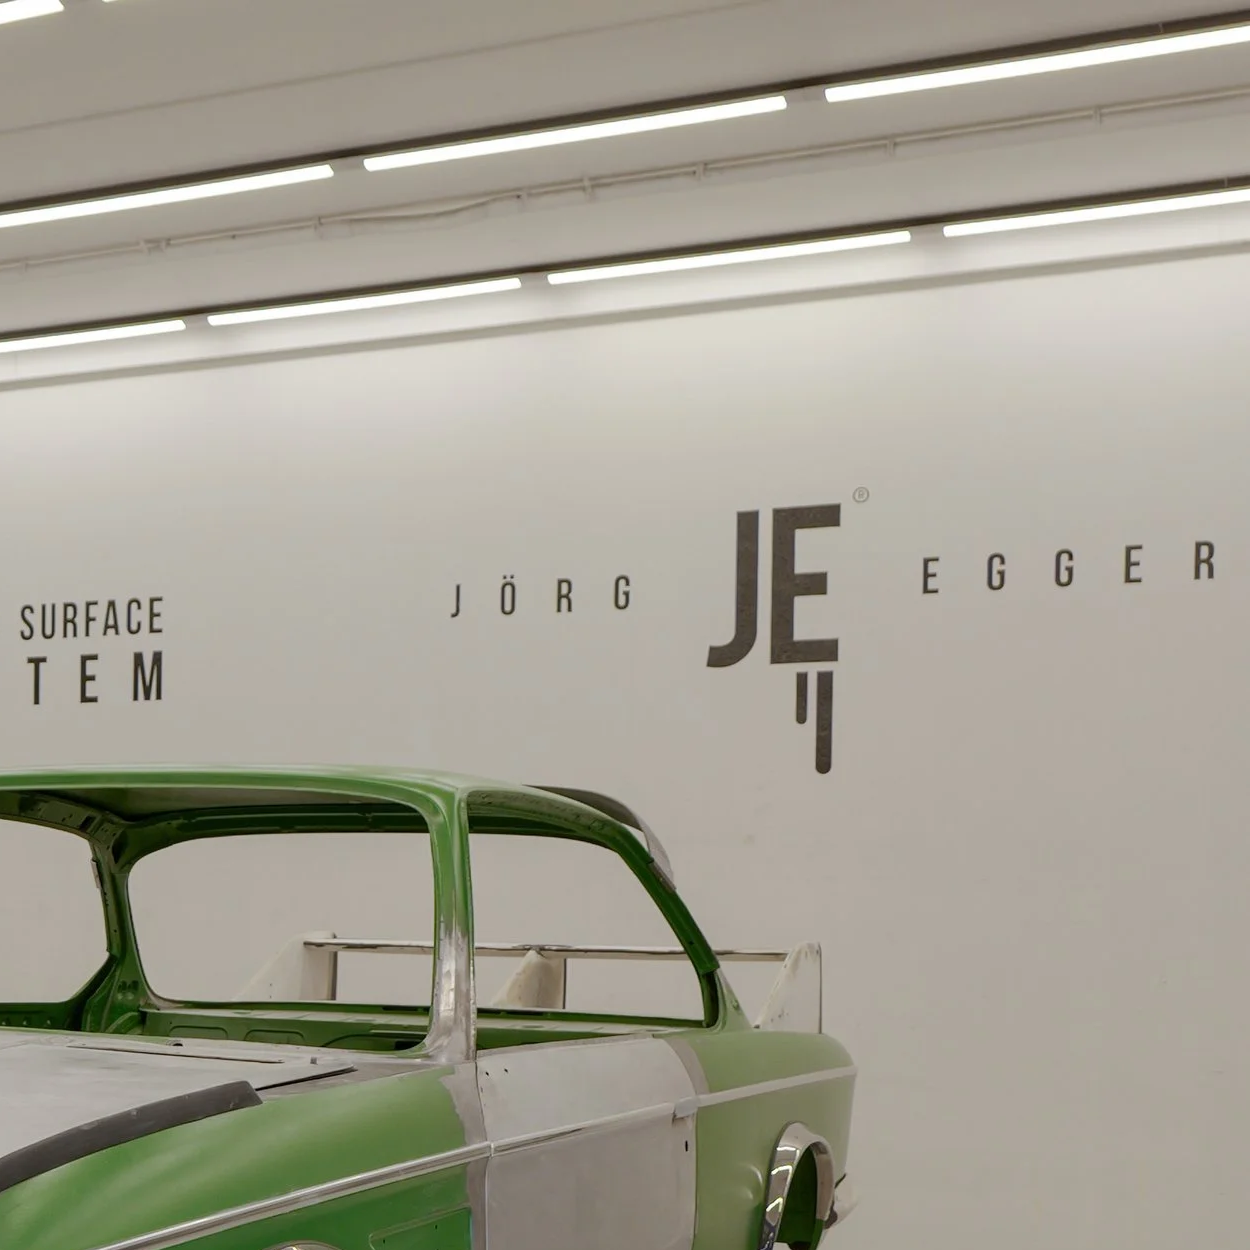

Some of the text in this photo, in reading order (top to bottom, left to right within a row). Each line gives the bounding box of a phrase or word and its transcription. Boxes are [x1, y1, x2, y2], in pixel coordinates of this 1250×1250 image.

[19, 596, 164, 641] SURFACE
[450, 502, 1216, 669] JÖRG JE EGGER
